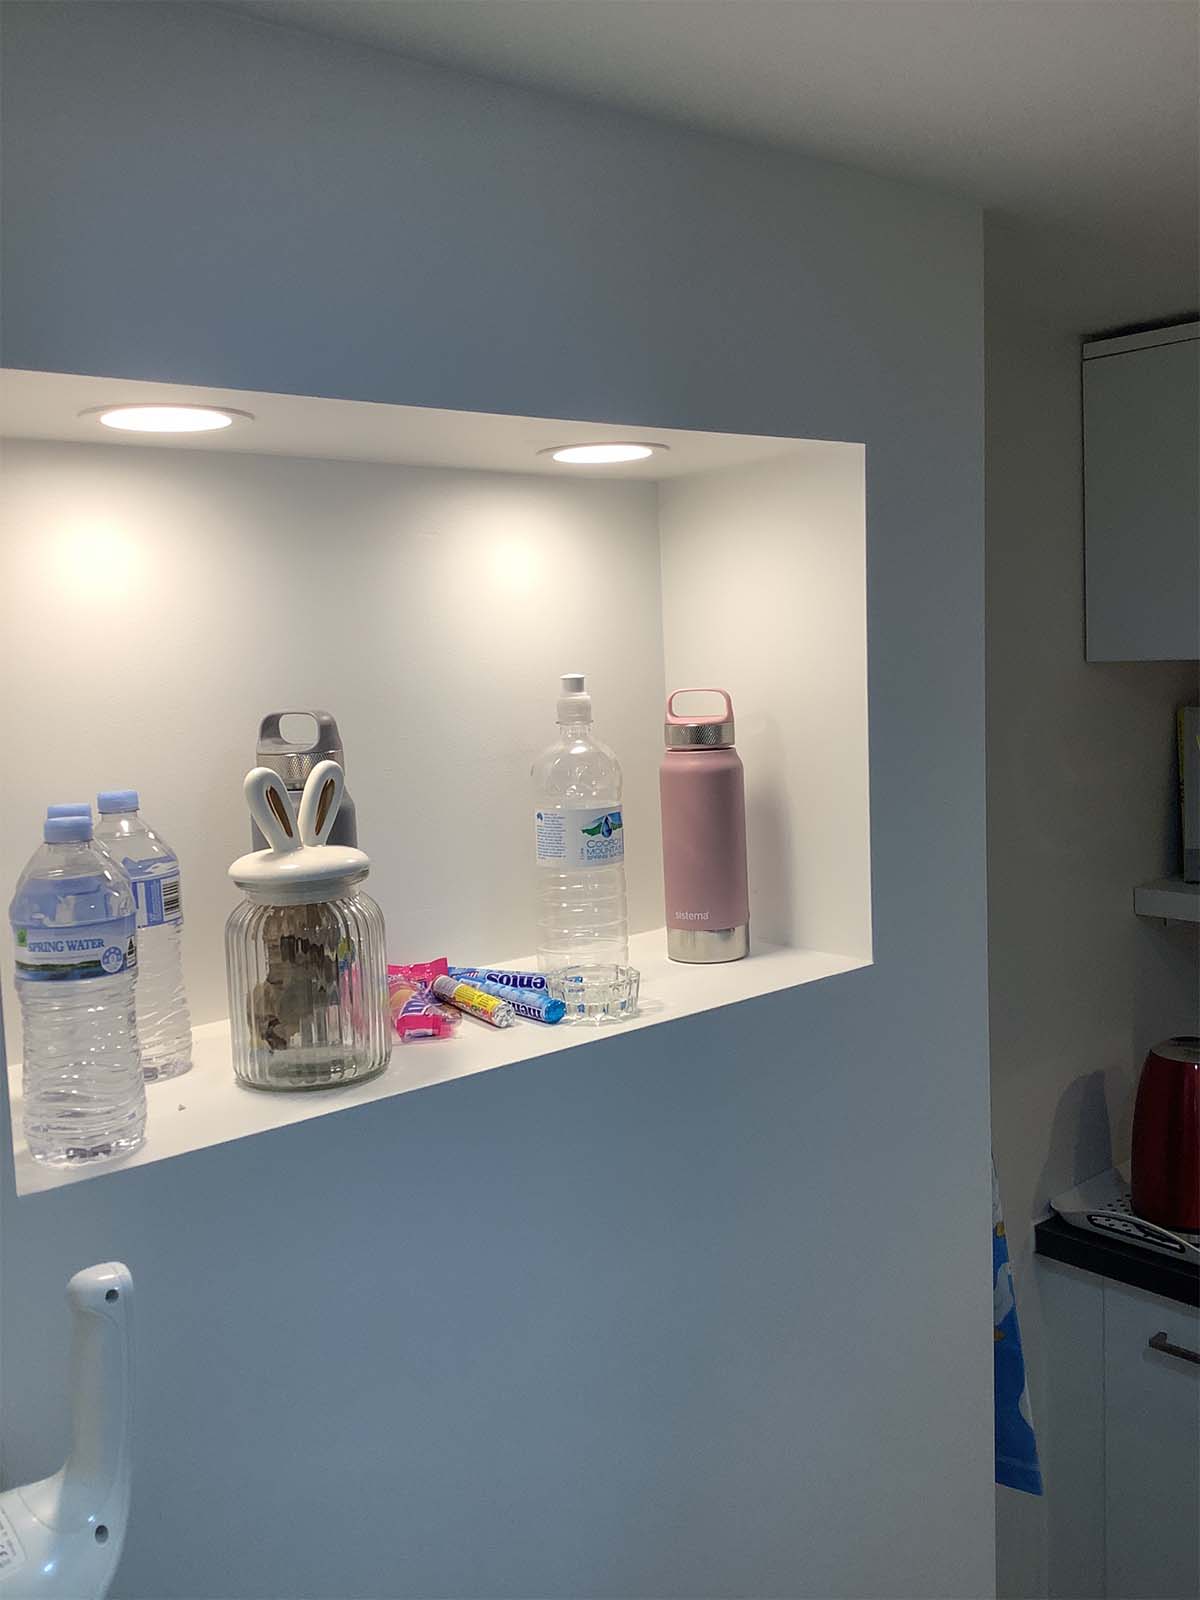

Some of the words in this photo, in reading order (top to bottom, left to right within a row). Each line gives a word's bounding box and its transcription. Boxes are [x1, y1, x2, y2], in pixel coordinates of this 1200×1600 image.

[674, 911, 709, 920] sistema
[28, 940, 64, 952] SPRING
[66, 938, 105, 950] WATER
[486, 973, 548, 989] entos
[507, 1000, 542, 1018] men
